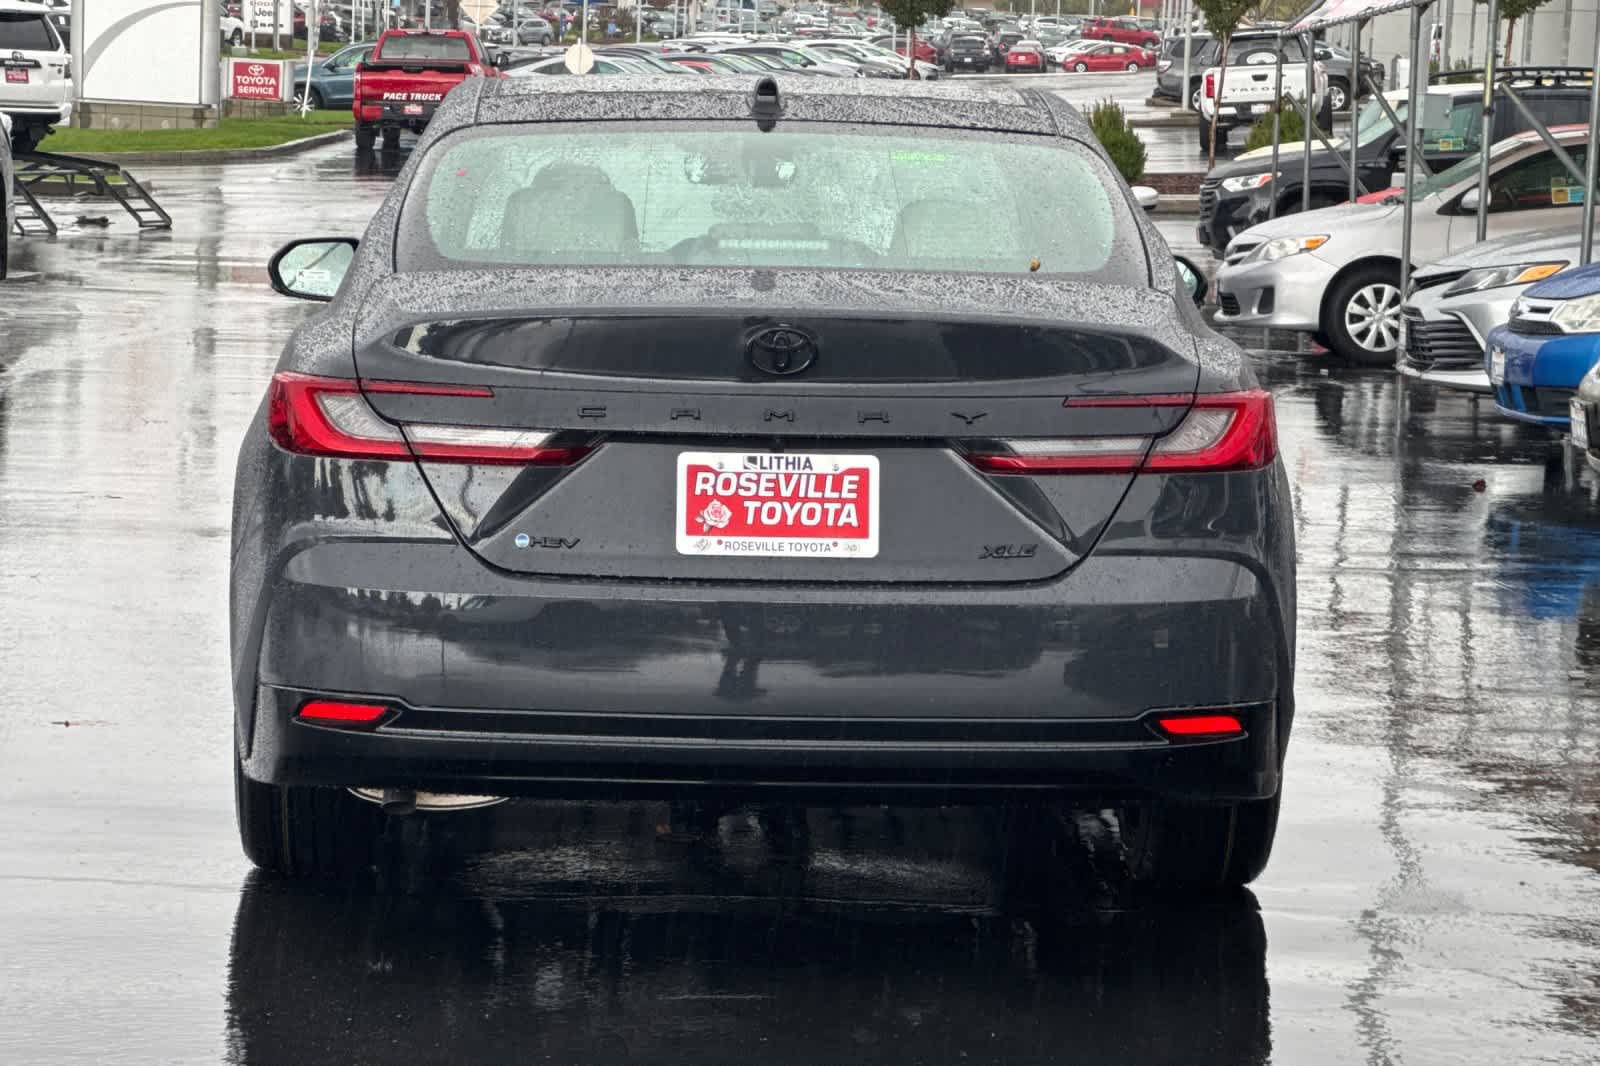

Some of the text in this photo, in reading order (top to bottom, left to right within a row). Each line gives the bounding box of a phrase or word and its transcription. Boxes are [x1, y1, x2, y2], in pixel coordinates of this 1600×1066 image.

[255, 8, 277, 16] Jee
[236, 75, 277, 86] TOYOTA
[238, 86, 275, 96] SERVICE
[383, 92, 443, 101] PACE TRUCK
[577, 406, 988, 424] CAMRY
[759, 455, 814, 471] LITHIA
[694, 471, 860, 499] ROSEVILLE
[743, 500, 859, 528] TOYOTA
[529, 535, 582, 549] HEV
[724, 540, 832, 553] ROSEVILLE TOYOTA
